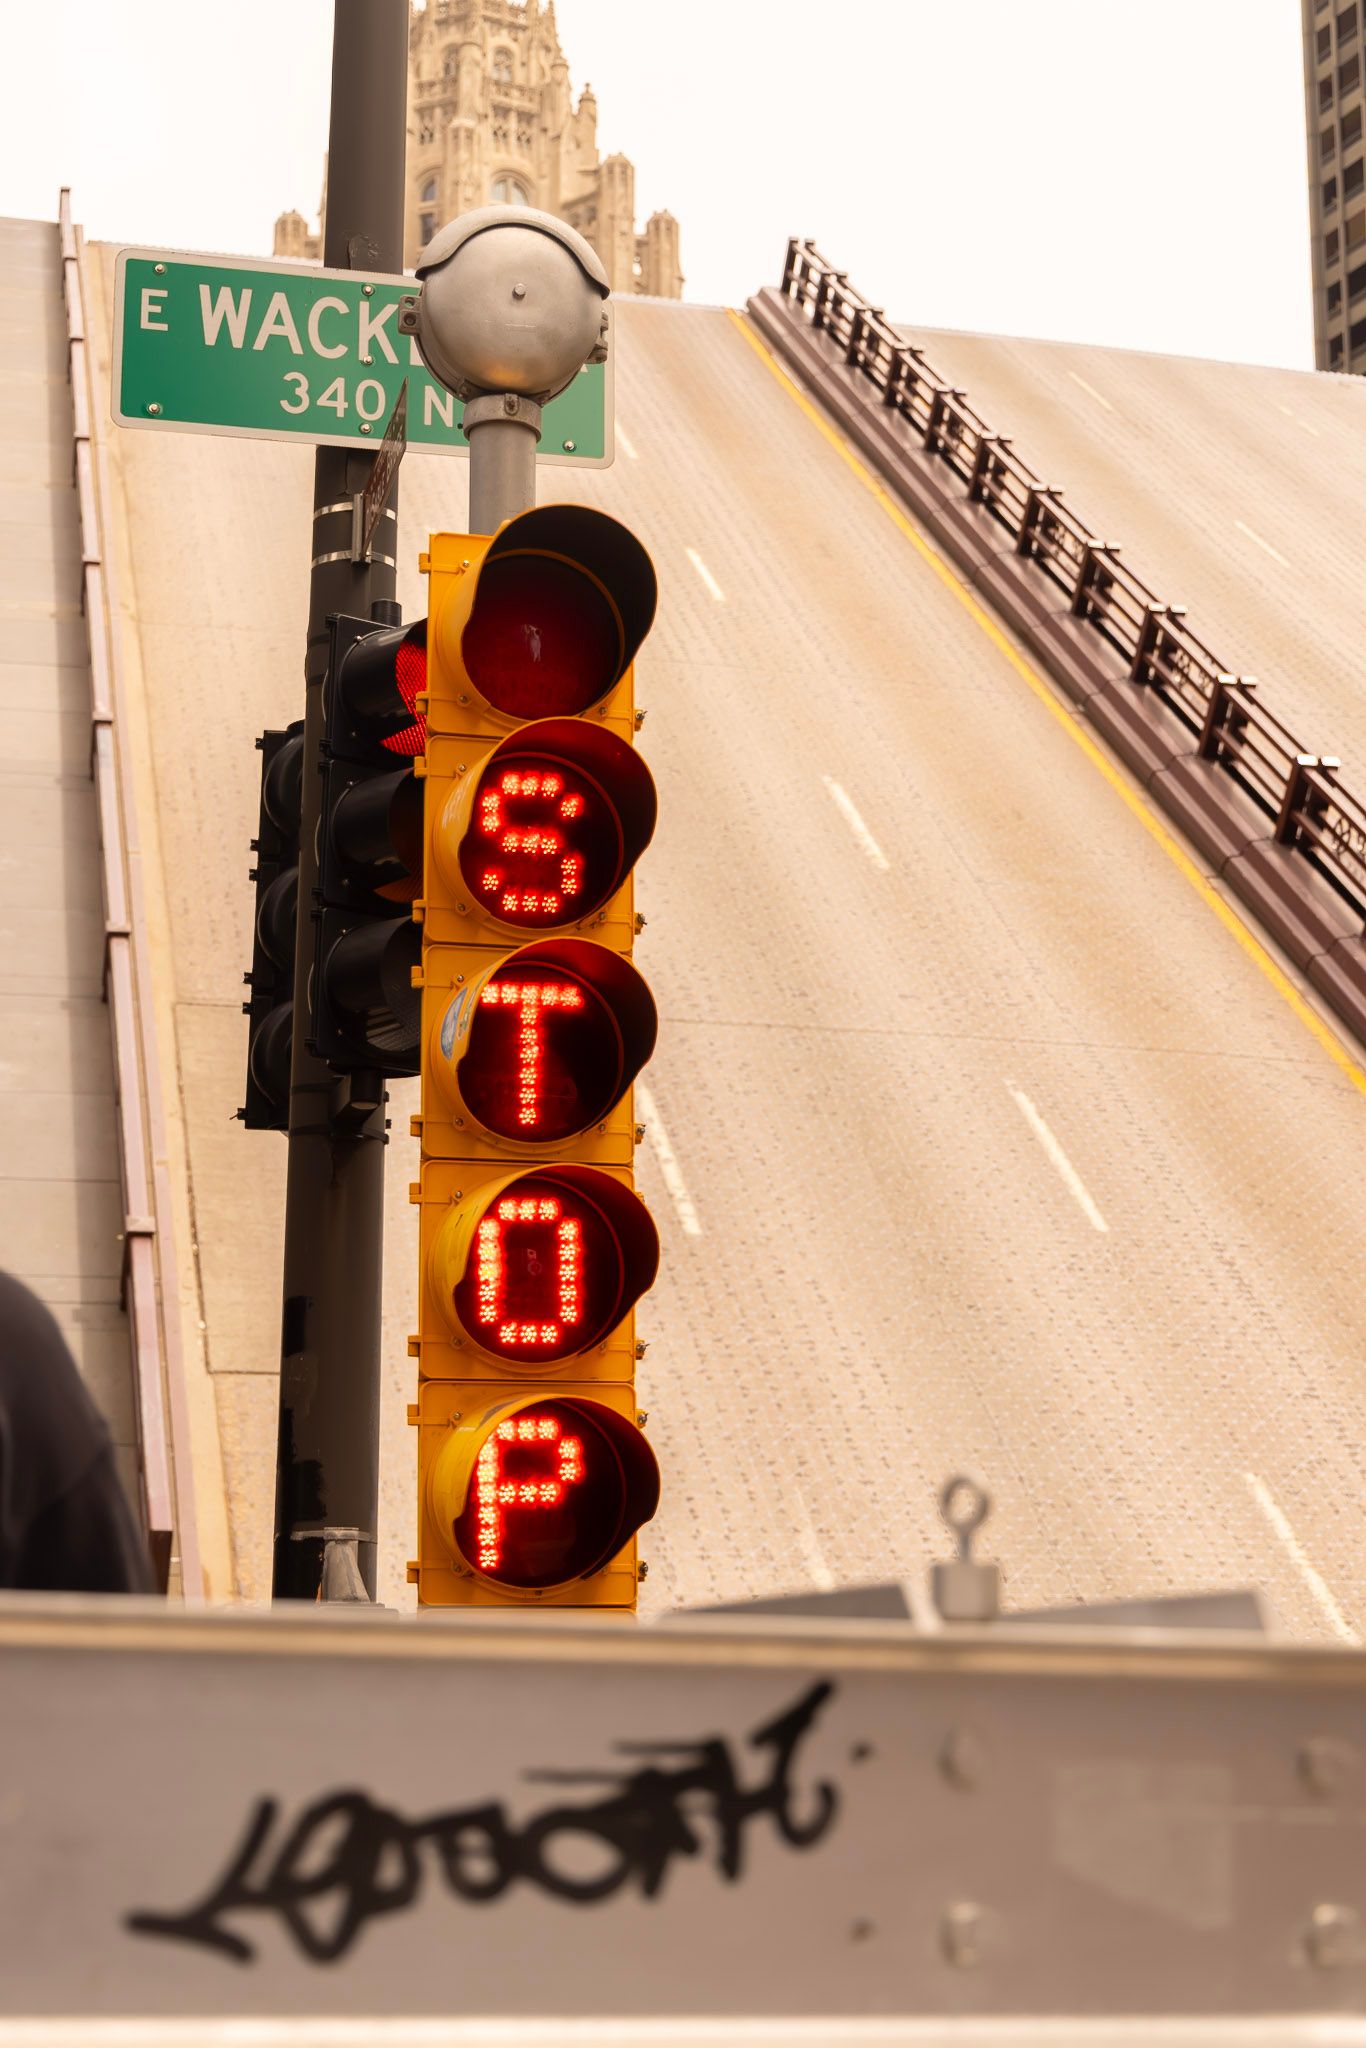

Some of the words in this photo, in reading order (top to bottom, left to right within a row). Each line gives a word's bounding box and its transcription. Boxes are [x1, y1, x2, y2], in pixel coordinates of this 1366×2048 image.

[140, 287, 169, 332] E
[198, 283, 425, 367] WACK
[279, 371, 387, 422] 340
[423, 385, 454, 428] N
[478, 771, 585, 1568] STOP
